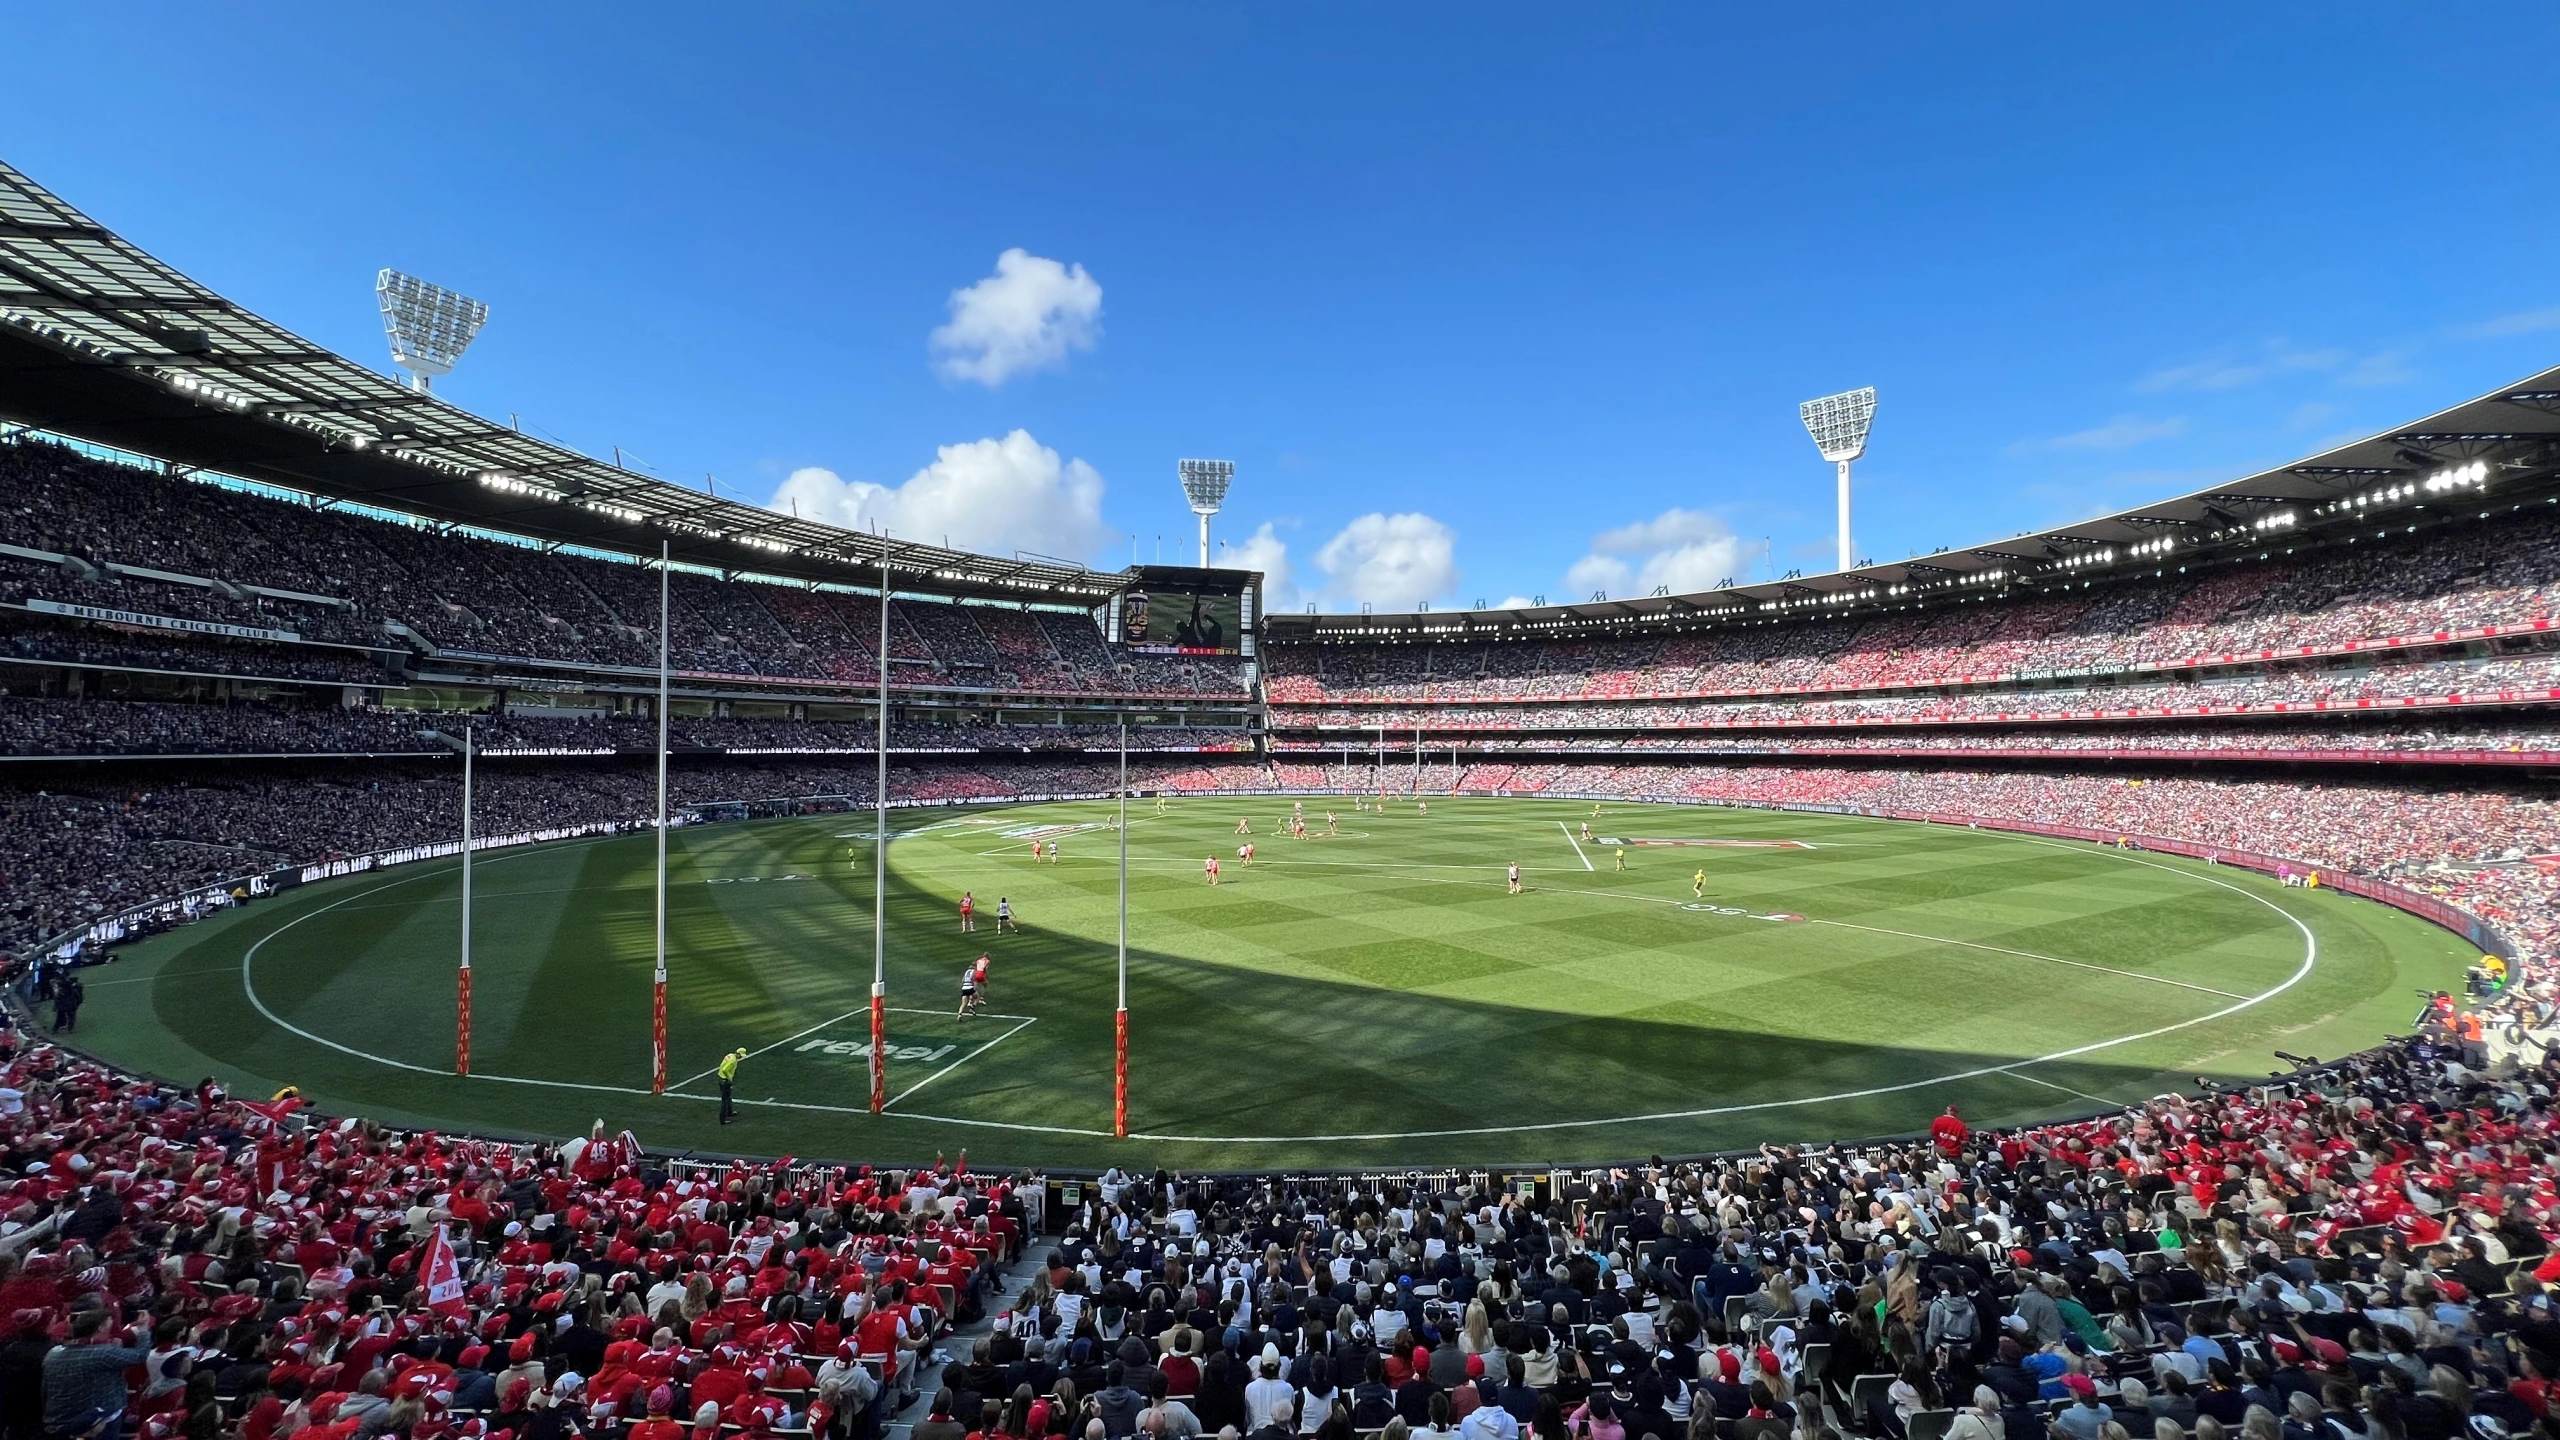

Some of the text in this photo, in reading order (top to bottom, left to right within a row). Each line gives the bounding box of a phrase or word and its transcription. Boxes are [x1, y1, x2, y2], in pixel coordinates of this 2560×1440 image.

[74, 606, 270, 638] MELBOURNE CRICKET CLUB
[2021, 664, 2125, 680] SHANE WARNE STAND
[794, 1038, 957, 1062] rebel
[590, 1141, 608, 1159] 46
